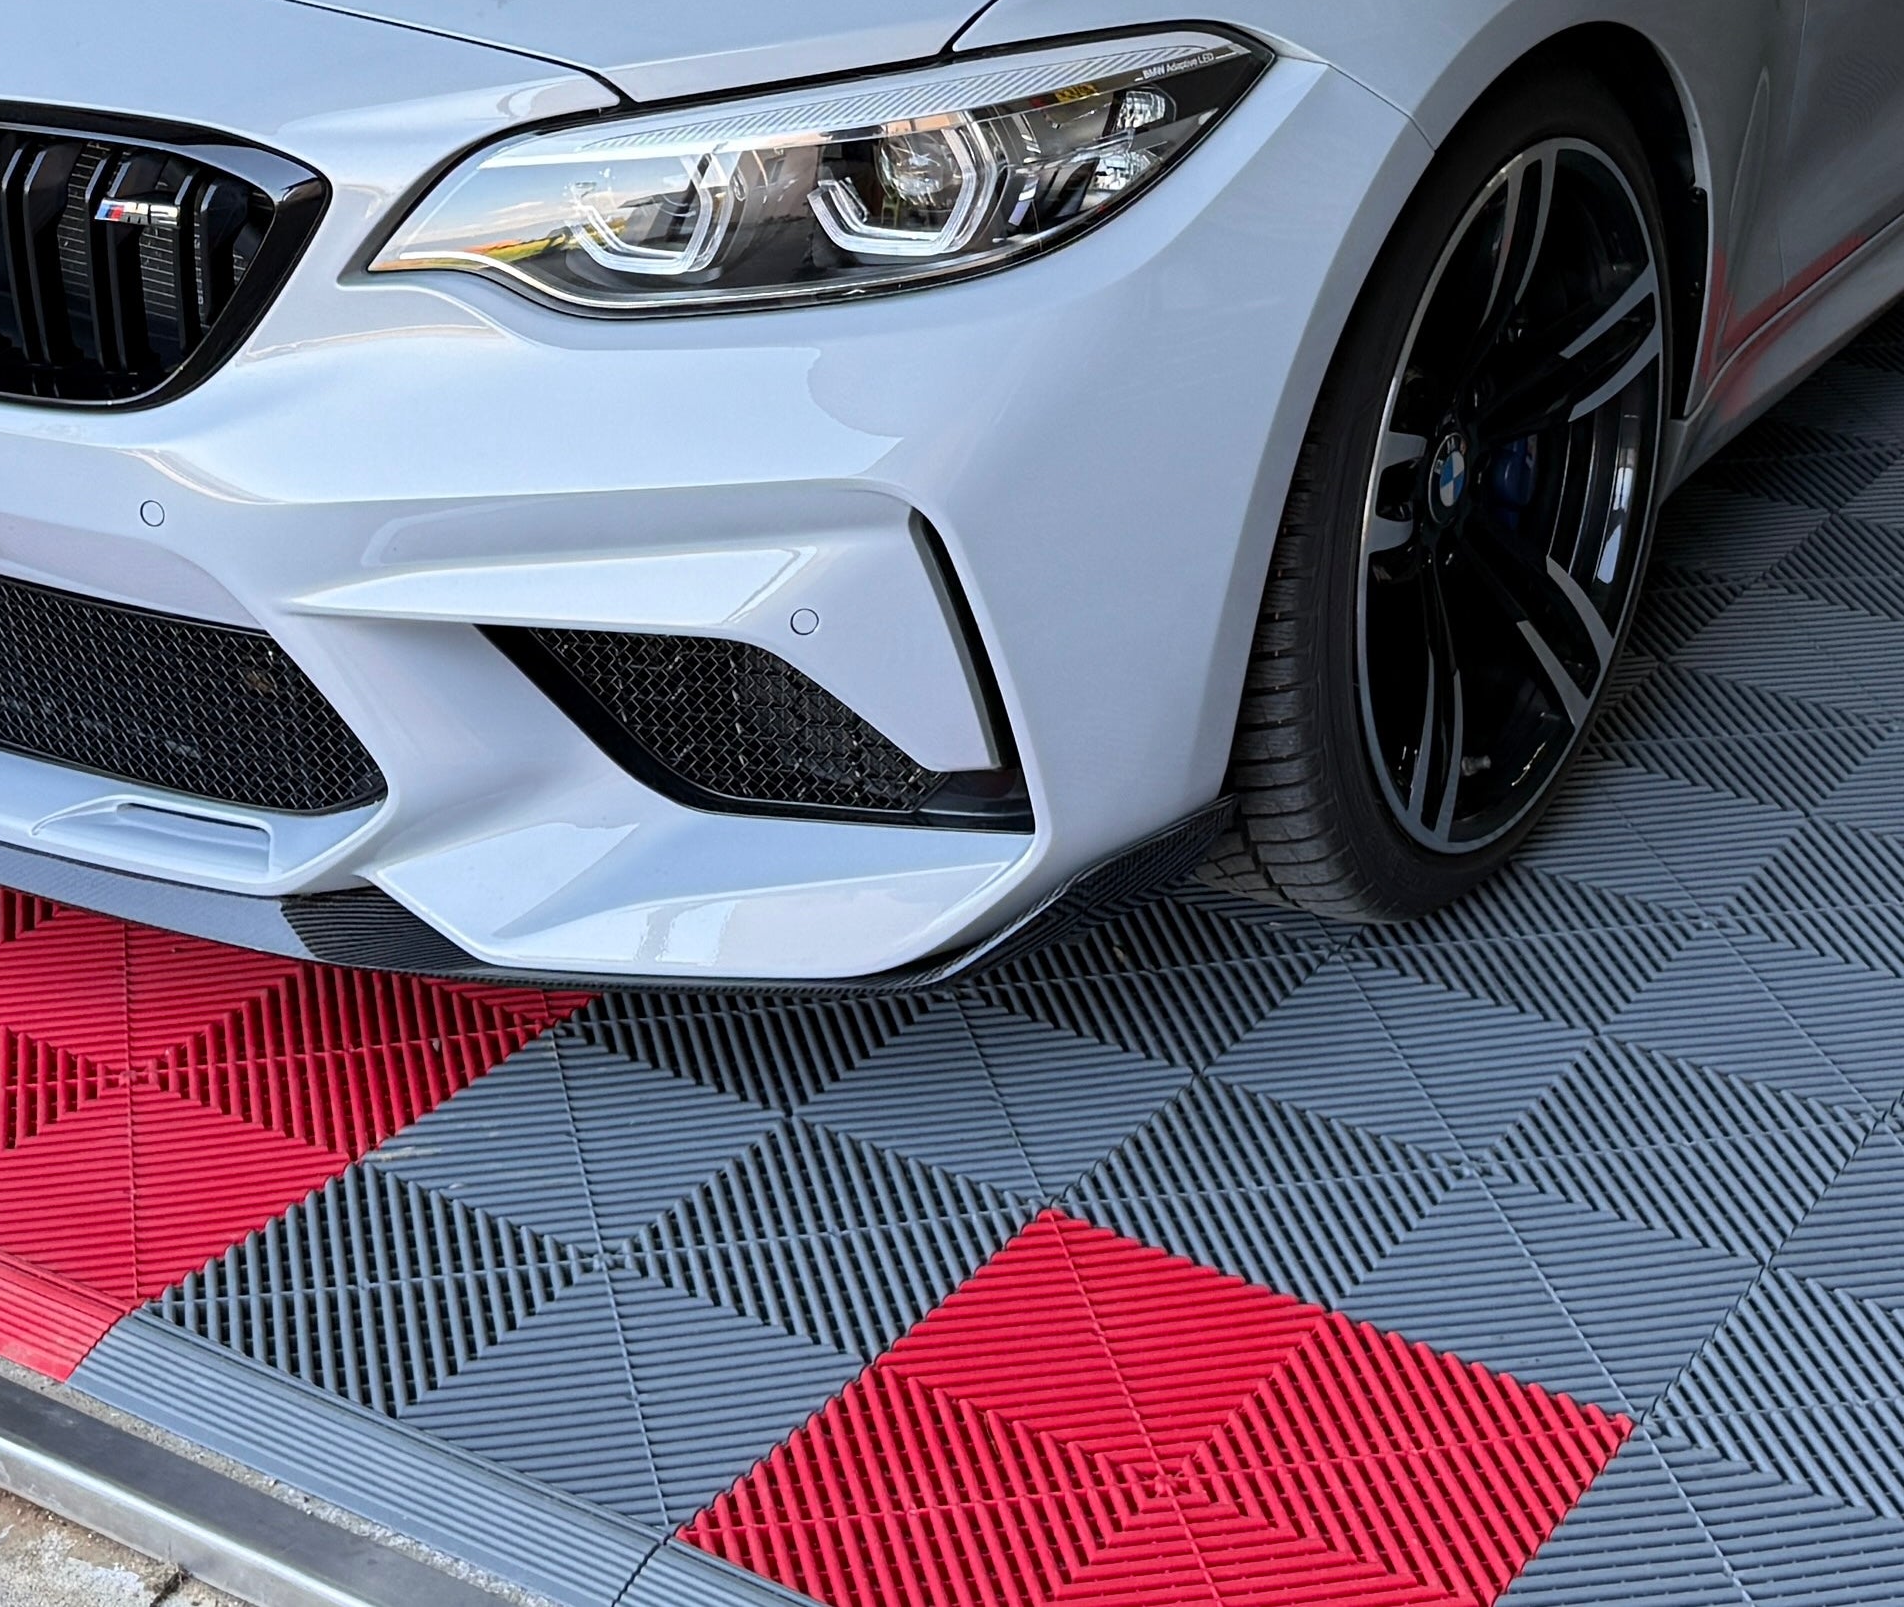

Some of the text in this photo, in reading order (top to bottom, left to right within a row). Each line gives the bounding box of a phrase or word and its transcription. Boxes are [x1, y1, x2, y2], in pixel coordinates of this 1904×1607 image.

[1142, 51, 1215, 80] BMW Adaptive LED
